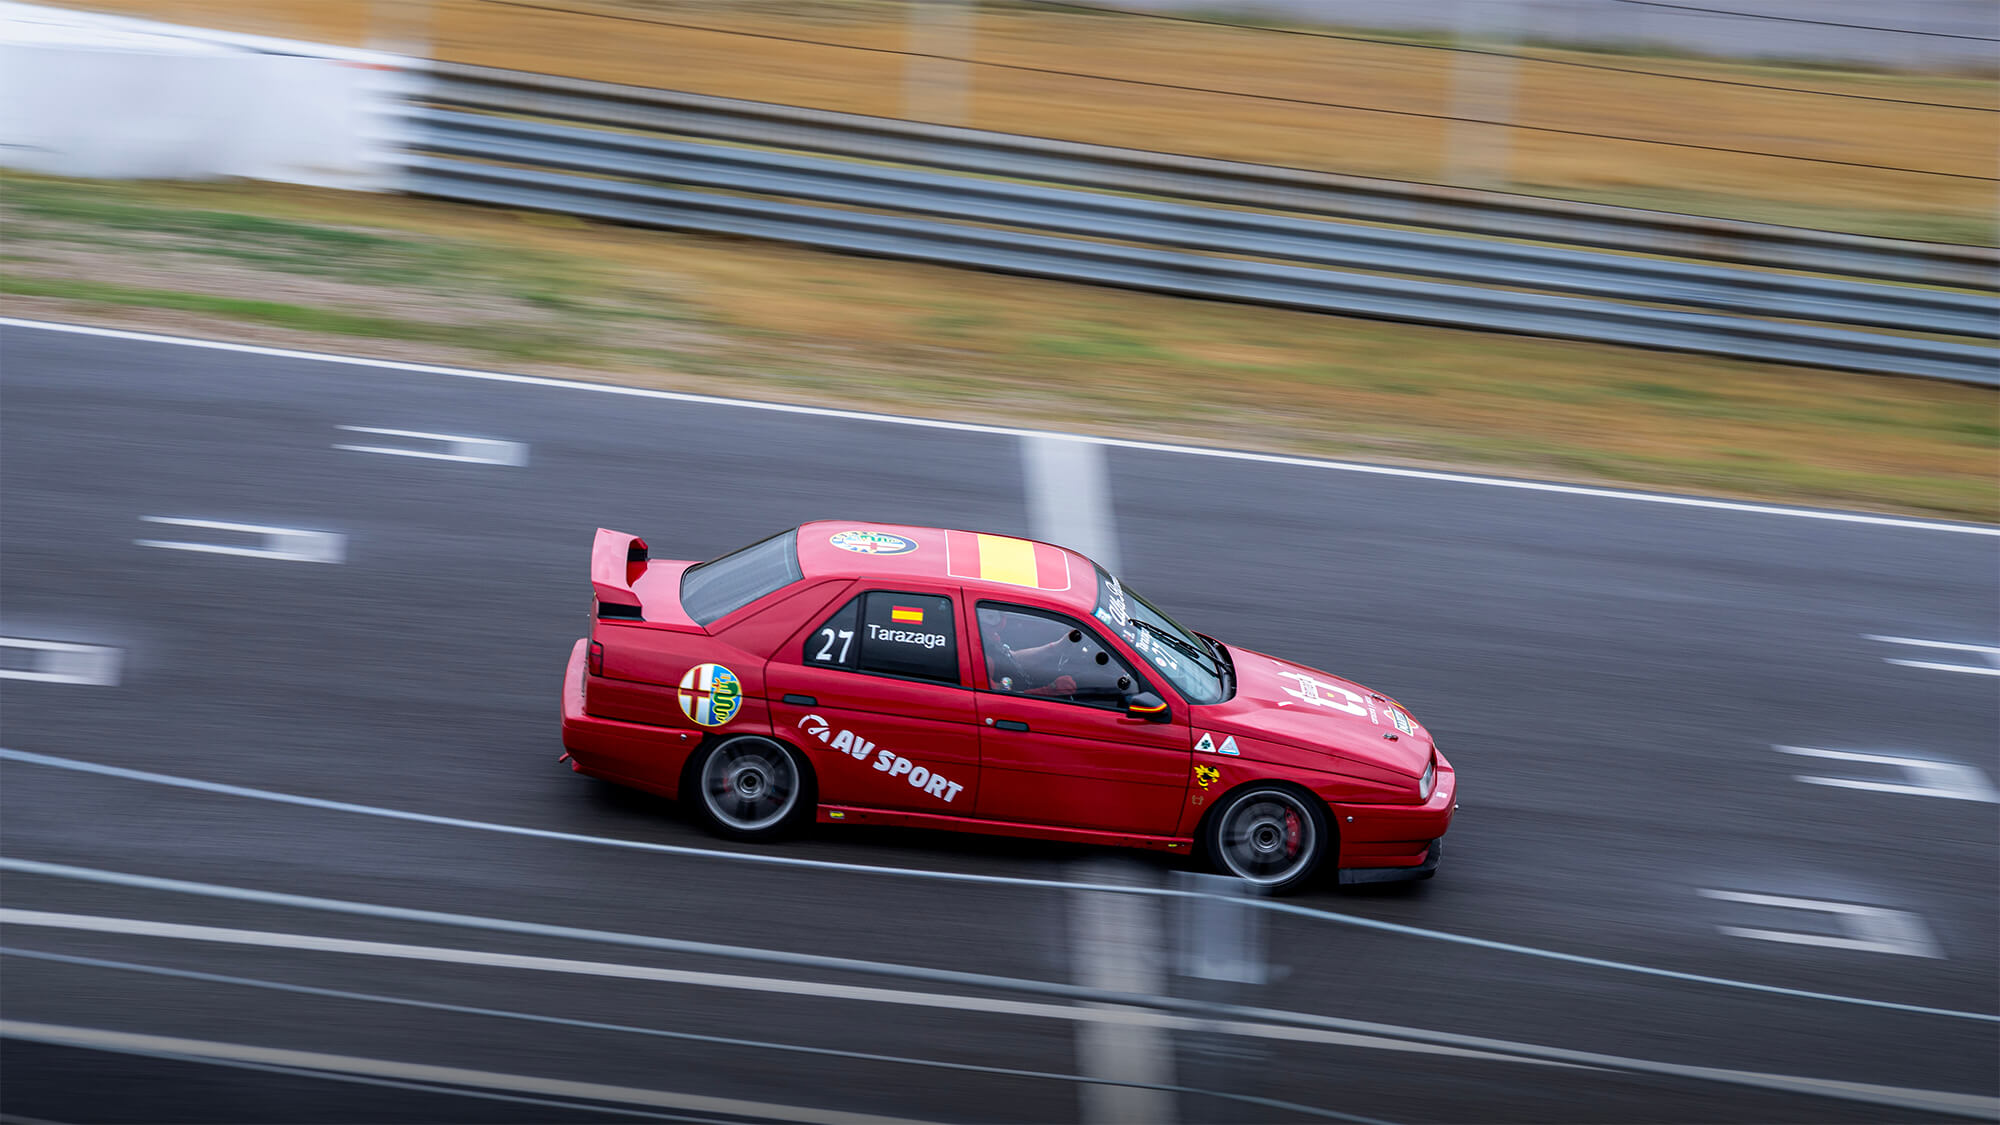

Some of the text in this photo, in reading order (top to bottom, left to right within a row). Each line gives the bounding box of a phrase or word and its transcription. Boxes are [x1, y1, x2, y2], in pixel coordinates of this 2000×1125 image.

[815, 628, 854, 663] 27
[867, 624, 946, 648] Tarazaga
[830, 729, 964, 802] AV SPORT
